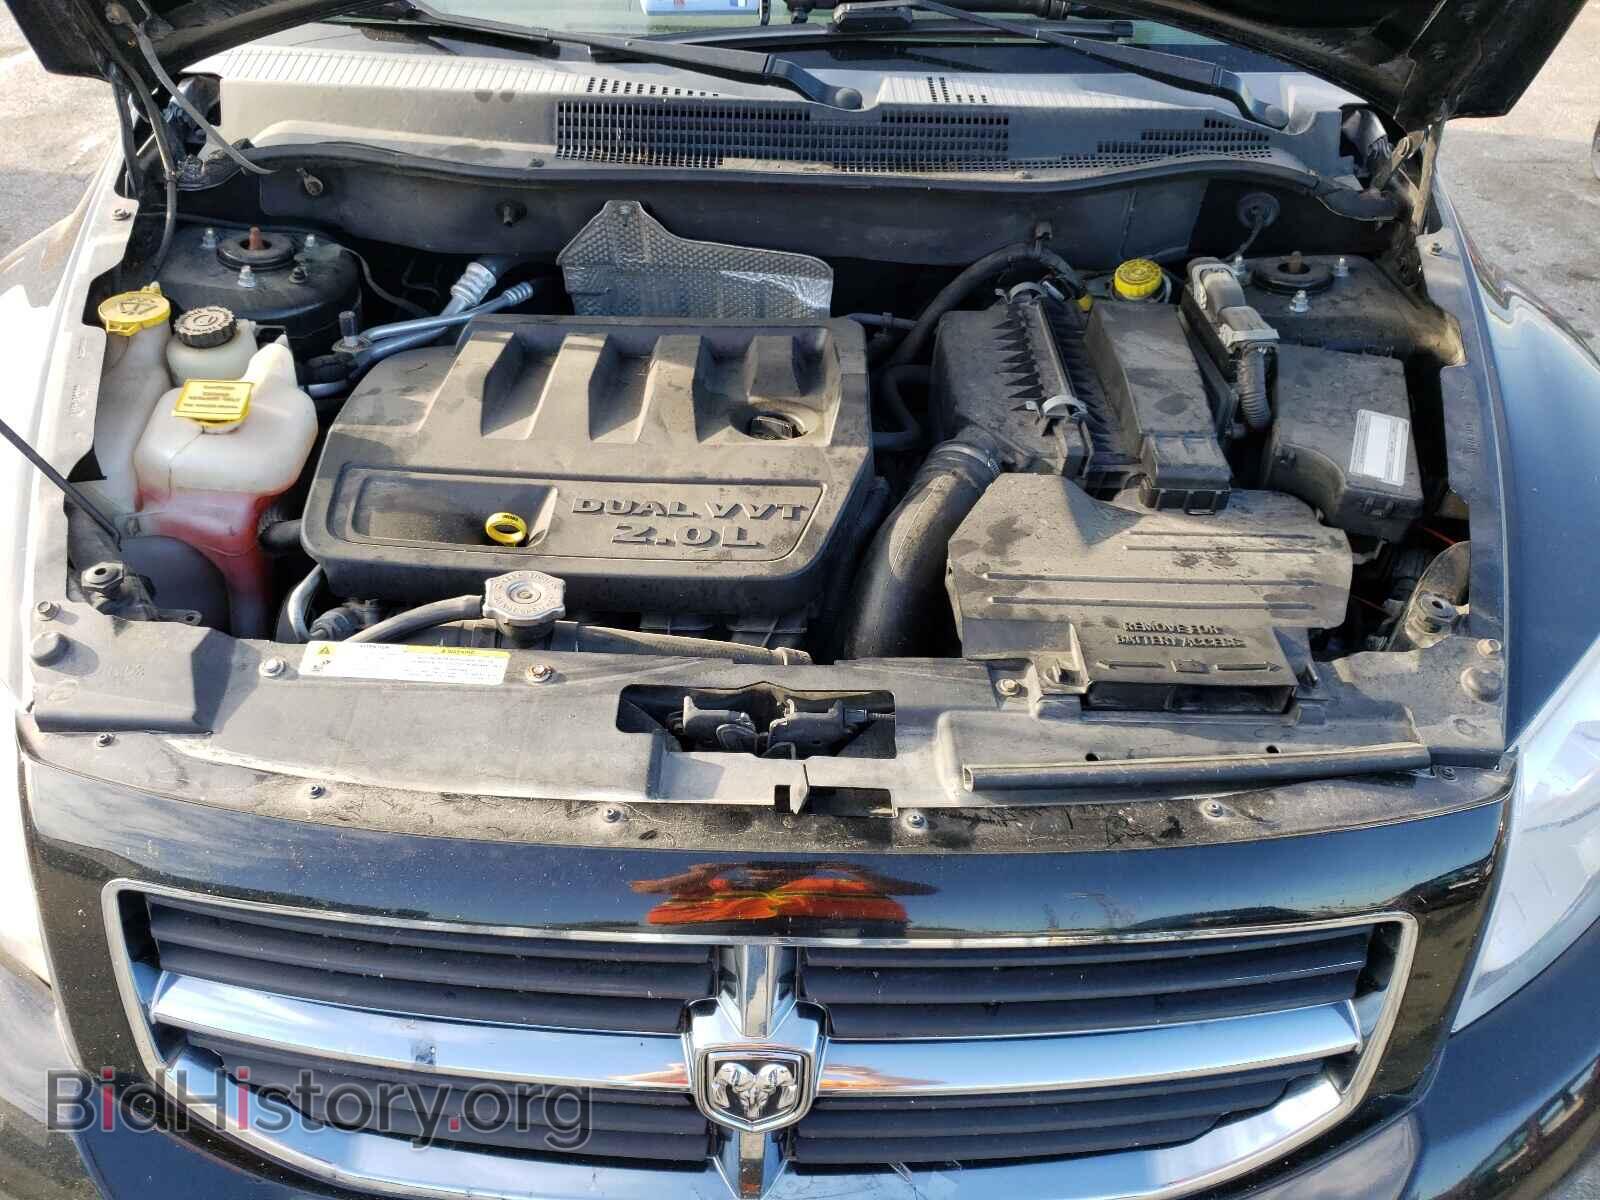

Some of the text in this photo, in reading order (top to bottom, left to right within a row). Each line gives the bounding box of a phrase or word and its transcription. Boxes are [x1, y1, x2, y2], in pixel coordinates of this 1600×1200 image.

[572, 499, 809, 521] DUAL VVT
[612, 523, 764, 548] 2.0L
[1123, 622, 1224, 636] REMOVE FOR
[1116, 635, 1248, 649] BATTERY ACCESS
